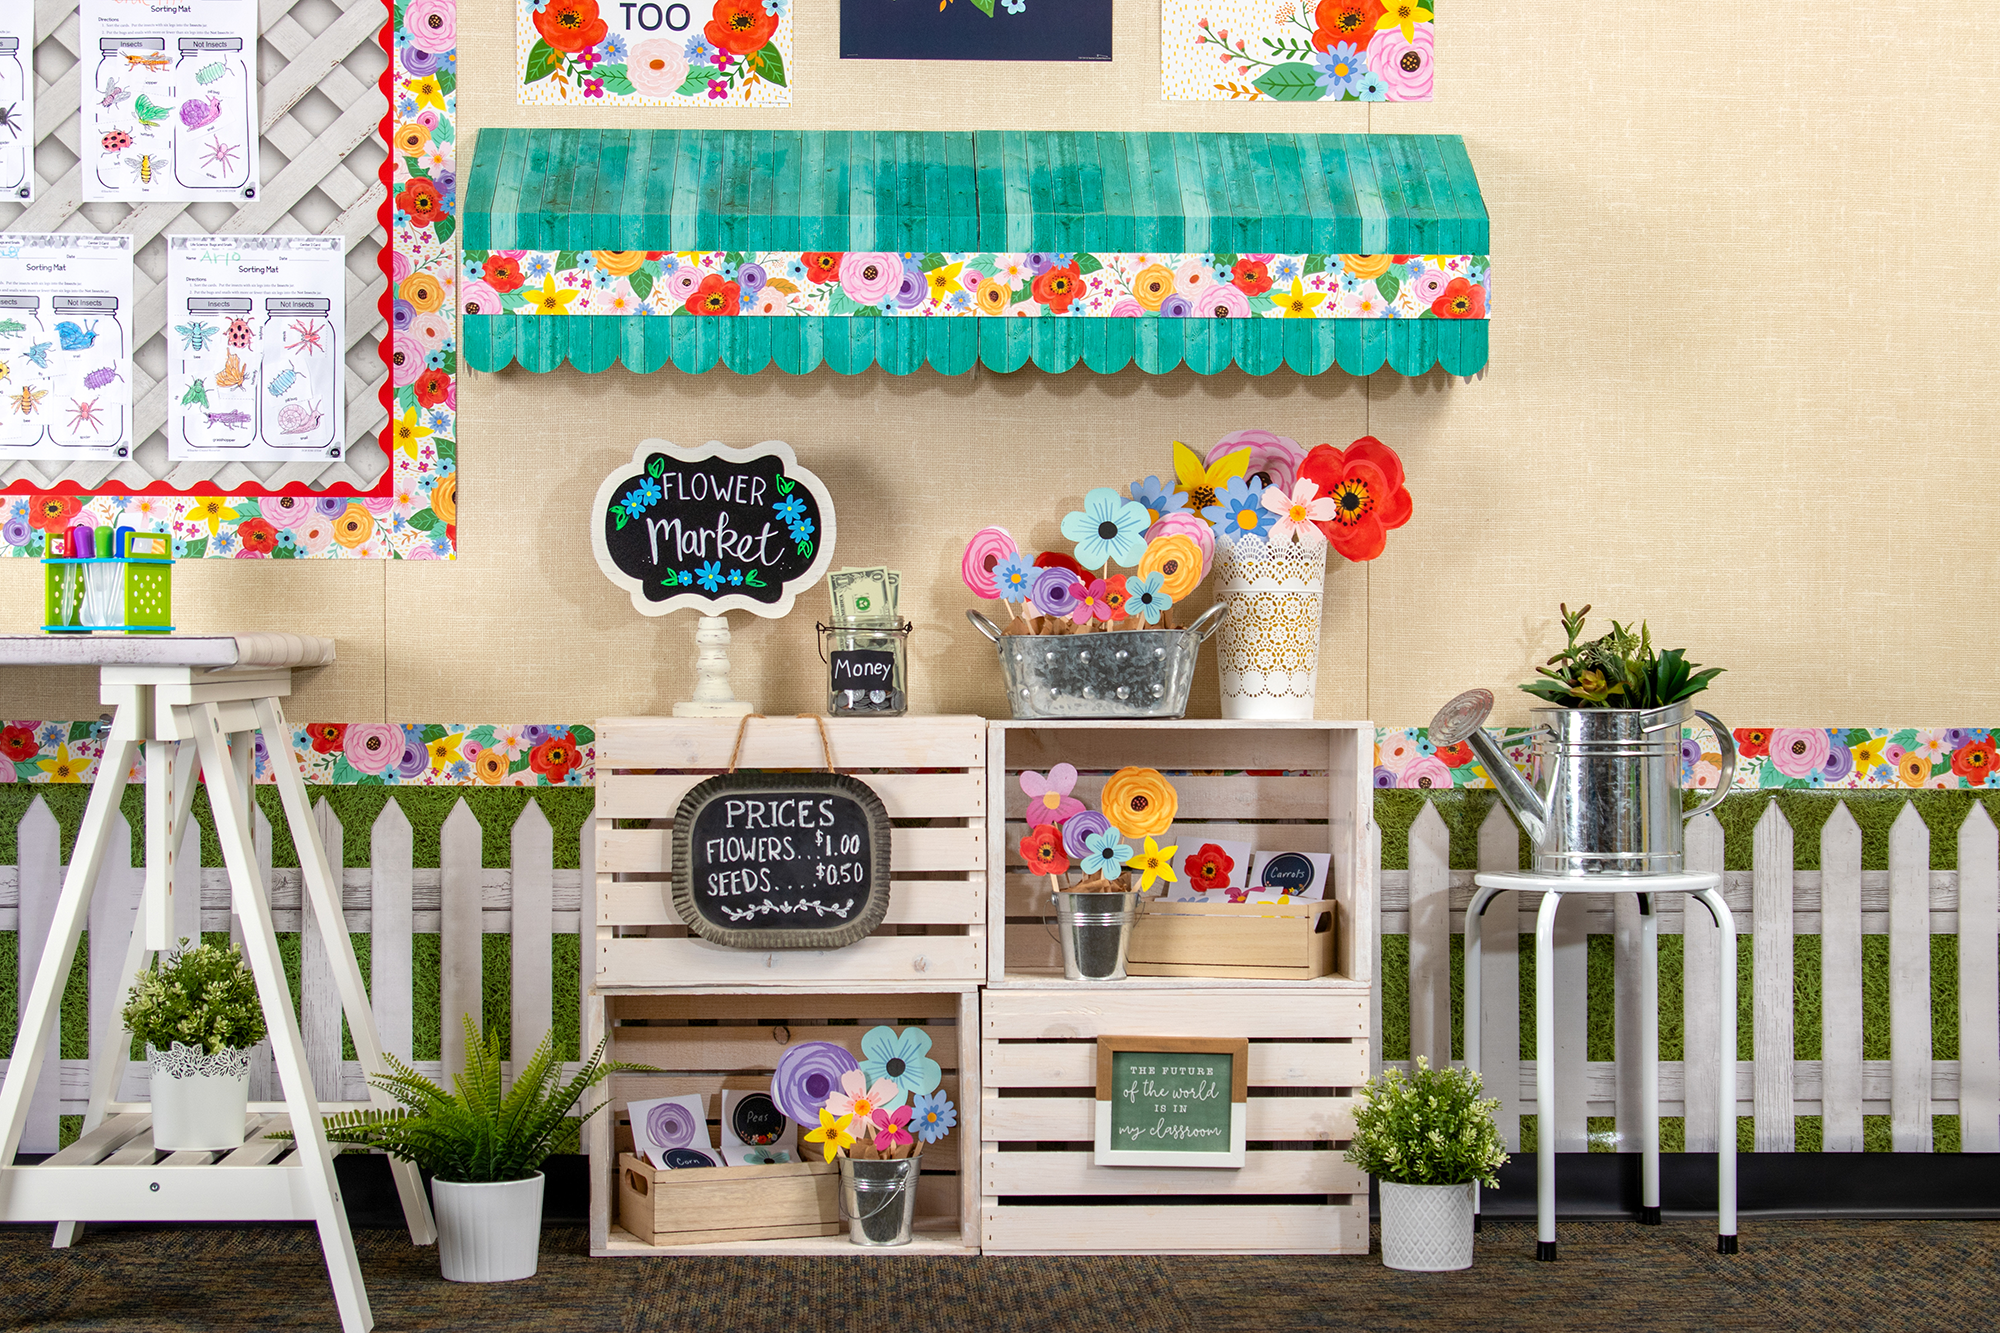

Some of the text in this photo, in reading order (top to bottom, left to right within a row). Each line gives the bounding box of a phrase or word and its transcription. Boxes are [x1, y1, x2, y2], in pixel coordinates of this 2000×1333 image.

[151, 5, 177, 14] Sorting
[620, 3, 690, 31] TOO
[26, 264, 52, 272] Sorting
[239, 266, 265, 274] Sorting
[661, 472, 766, 506] FLOWER
[646, 511, 785, 566] Market
[834, 659, 891, 681] Money
[725, 799, 835, 829] PRICES
[815, 829, 860, 857] $1.00
[816, 862, 863, 885] $0.50
[1270, 866, 1305, 879] Carrots
[1130, 1066, 1214, 1075] THE FUTURE
[1123, 1079, 1219, 1103] of the world
[746, 1111, 768, 1123] Peas
[1154, 1104, 1187, 1113] IS IN
[1119, 1118, 1221, 1141] my classroom
[676, 1157, 700, 1166] Corn
